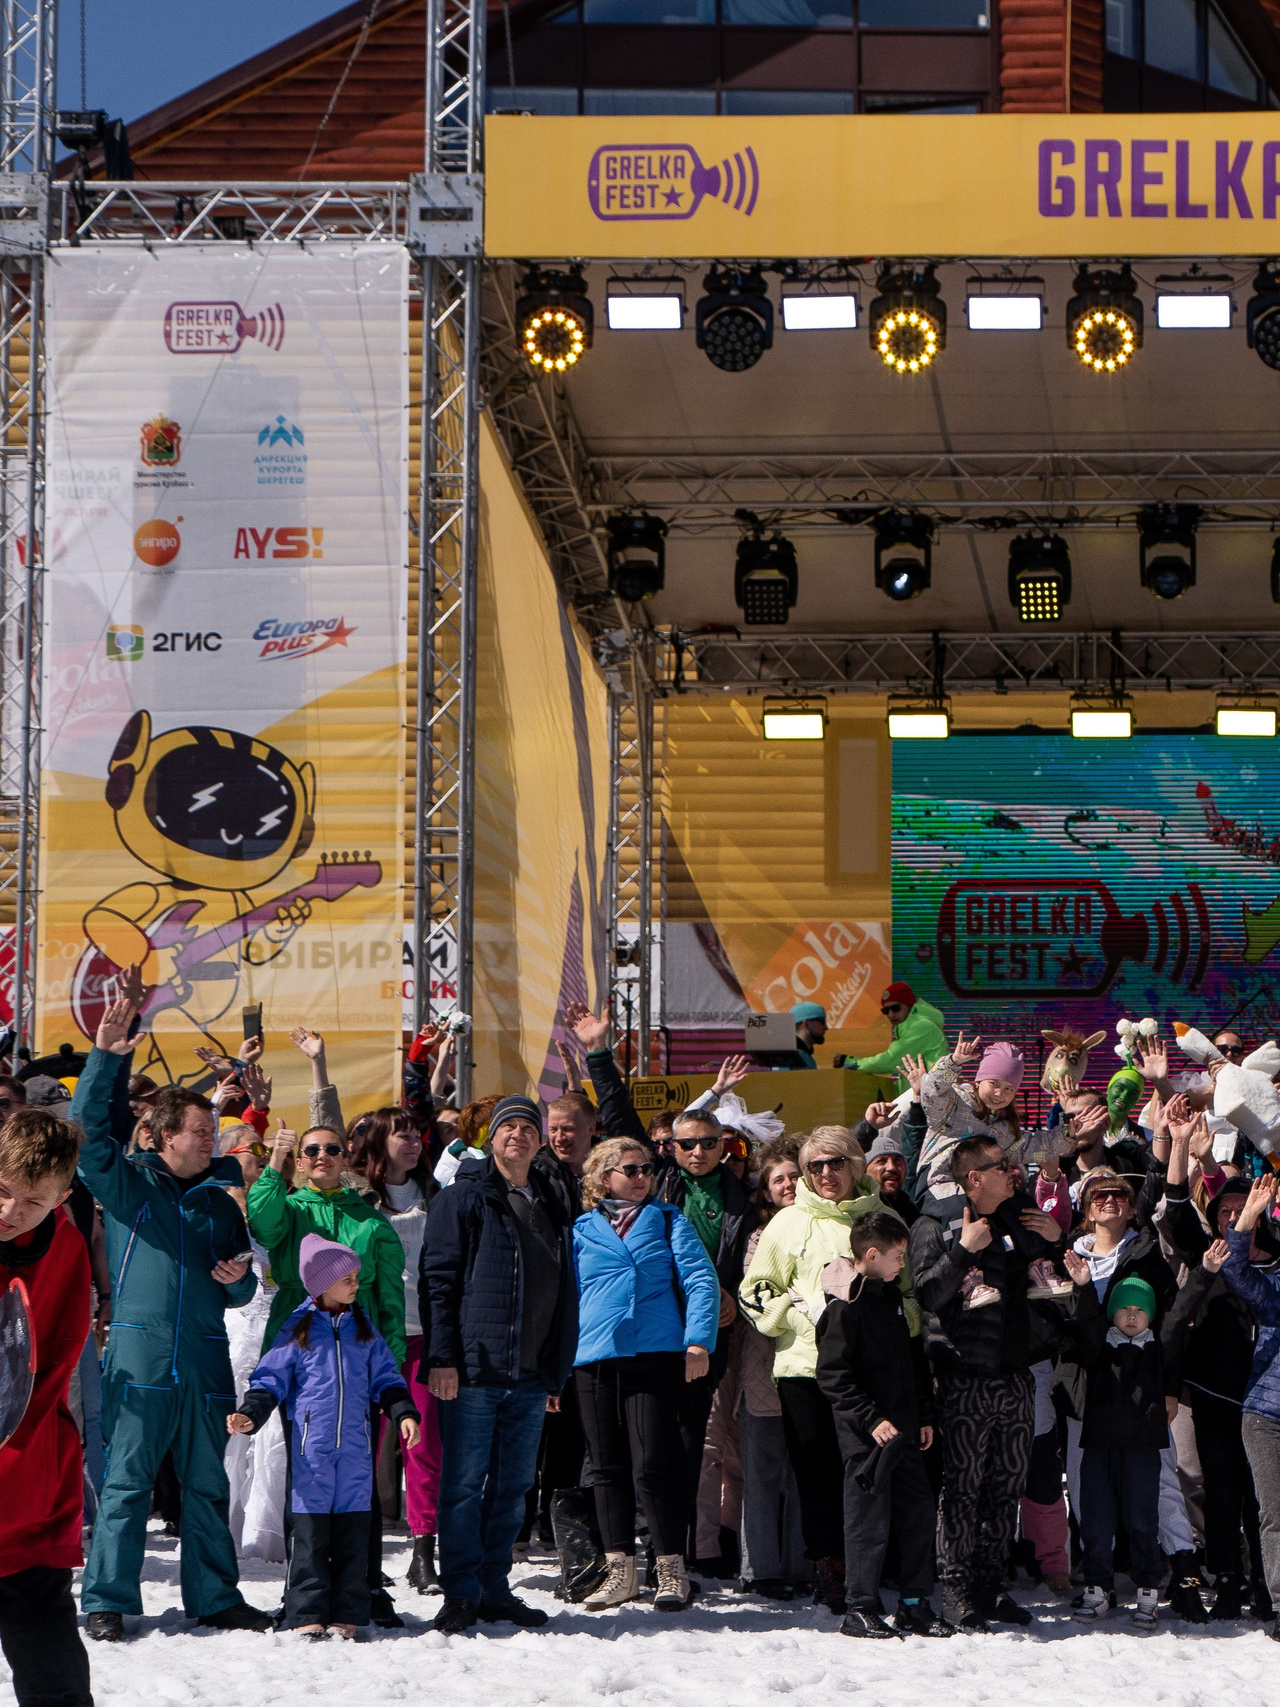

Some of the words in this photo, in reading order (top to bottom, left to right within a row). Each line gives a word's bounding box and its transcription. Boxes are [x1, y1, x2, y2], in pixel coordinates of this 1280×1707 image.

[605, 154, 686, 180] GRELKA
[605, 184, 658, 209] FEST
[176, 308, 234, 326] GRELKA
[176, 329, 216, 346] FEST
[253, 455, 308, 465] ДИРЕКЦИЯ
[258, 466, 303, 474] КУРОРТА
[257, 476, 304, 485] ШЕРЕГЕШ
[234, 527, 324, 559] AYS!
[152, 631, 223, 652] 2ГИС
[965, 896, 1094, 935] GRELKA
[965, 942, 1051, 980] FEST
[635, 1083, 665, 1096] GRELKA
[635, 1096, 656, 1105] FEST
